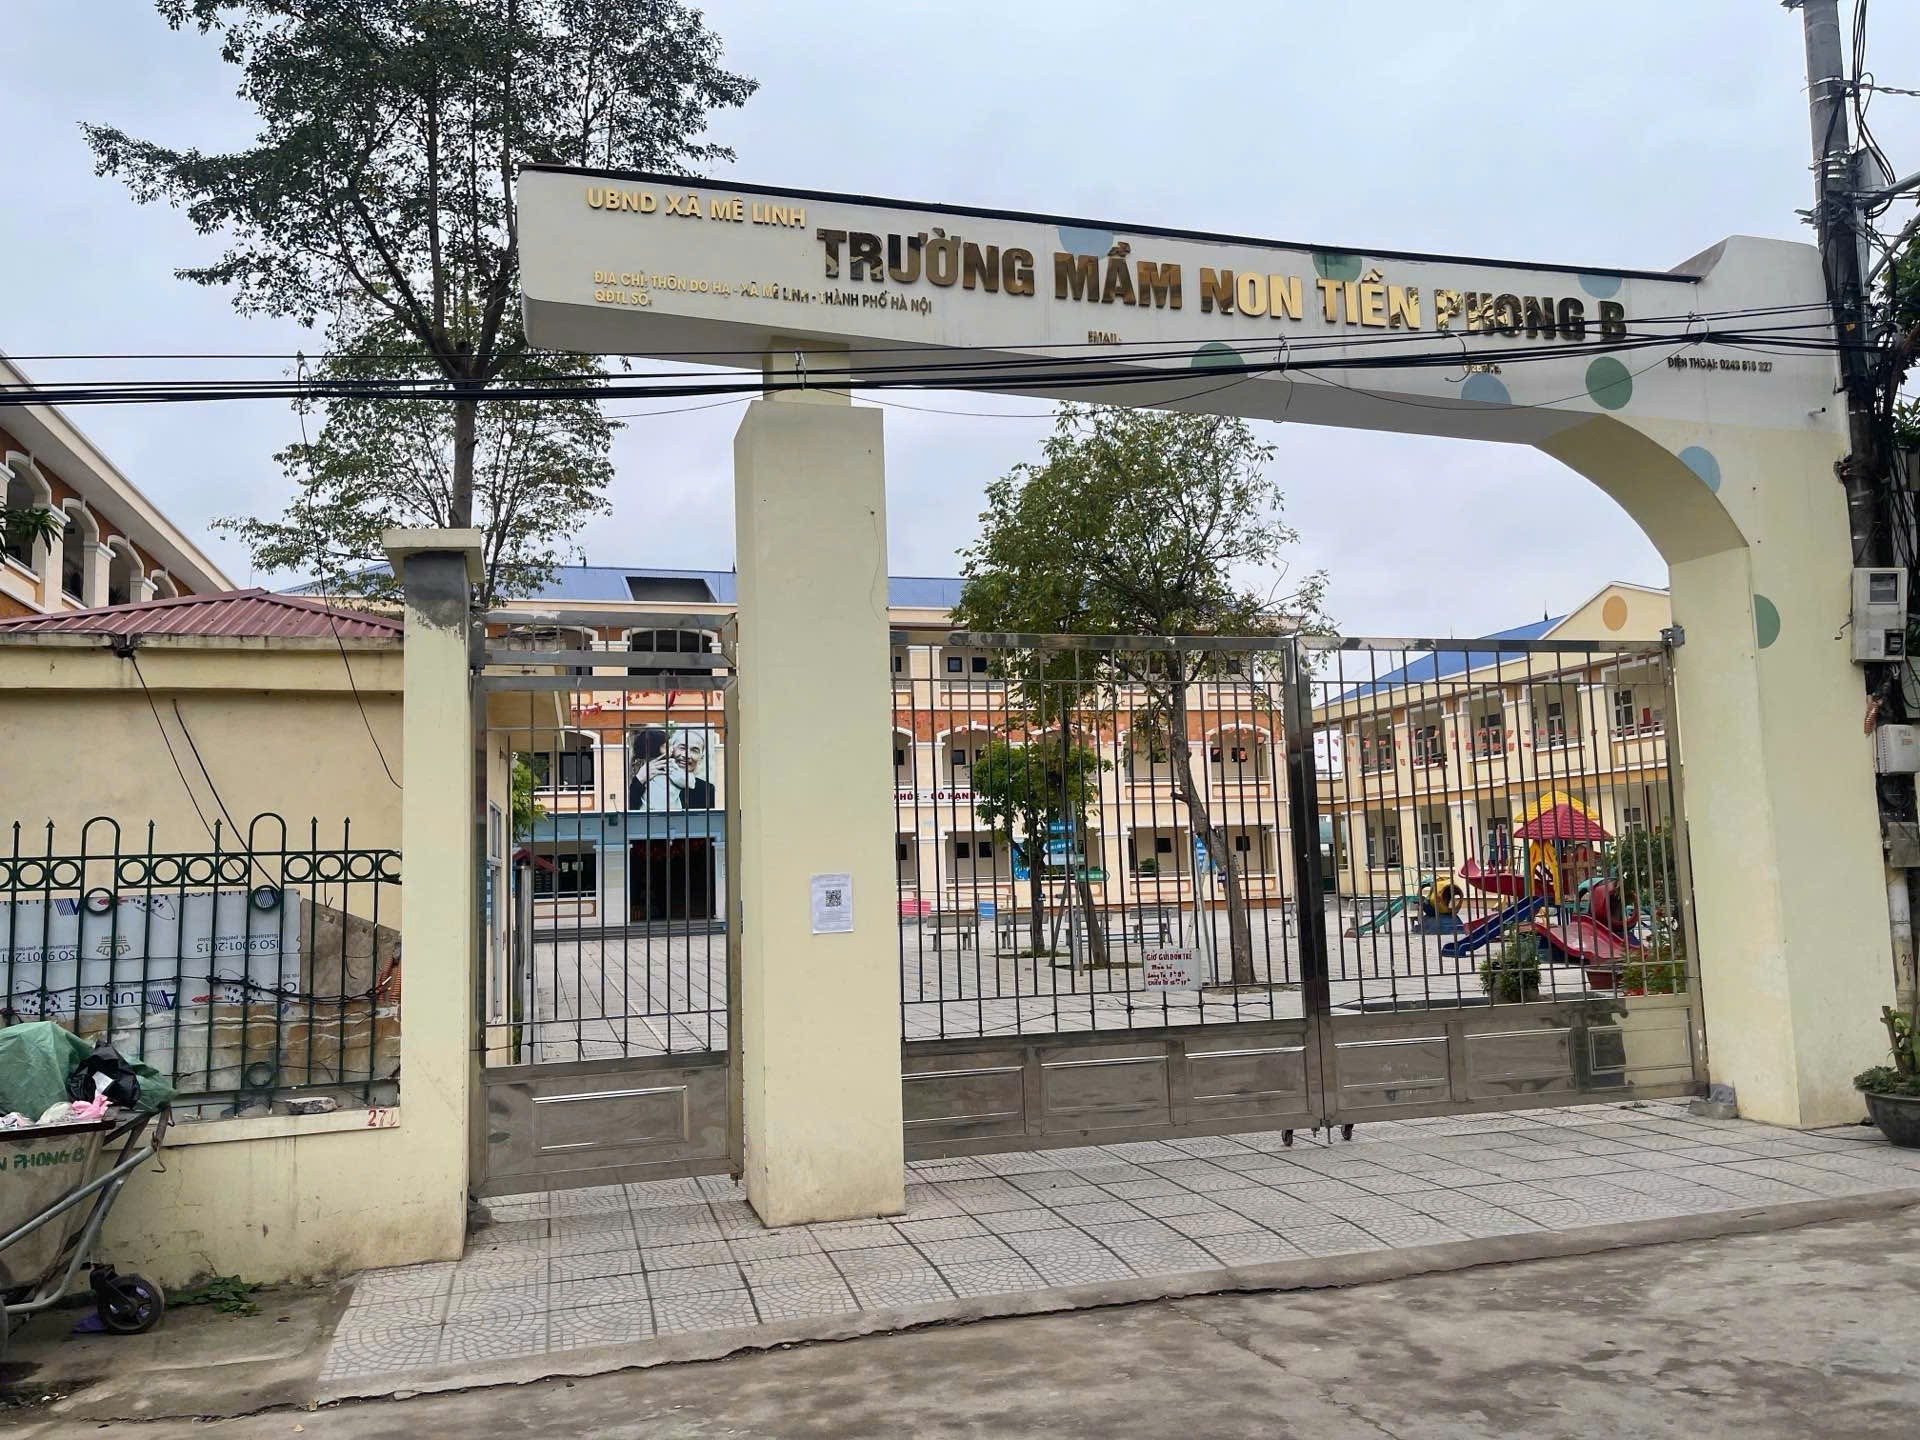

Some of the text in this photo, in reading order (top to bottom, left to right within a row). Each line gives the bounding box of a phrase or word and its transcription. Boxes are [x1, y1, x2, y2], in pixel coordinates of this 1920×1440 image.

[586, 187, 806, 228] UBND XÃ MÊ LINH
[594, 289, 628, 304] QĐTL
[651, 274, 687, 292] THÔN
[689, 280, 709, 293] DO
[741, 282, 759, 297] XÃ
[762, 282, 779, 300] MÊ
[819, 288, 859, 307] THÀNH
[863, 290, 888, 309] PHỐ
[890, 294, 908, 312] HÀ
[911, 297, 932, 316] NỘI
[817, 227, 1627, 342] TRƯỜNG MẦM NON TIỀN PHONG B
[59, 950, 80, 960] SO
[260, 940, 279, 950] ISO
